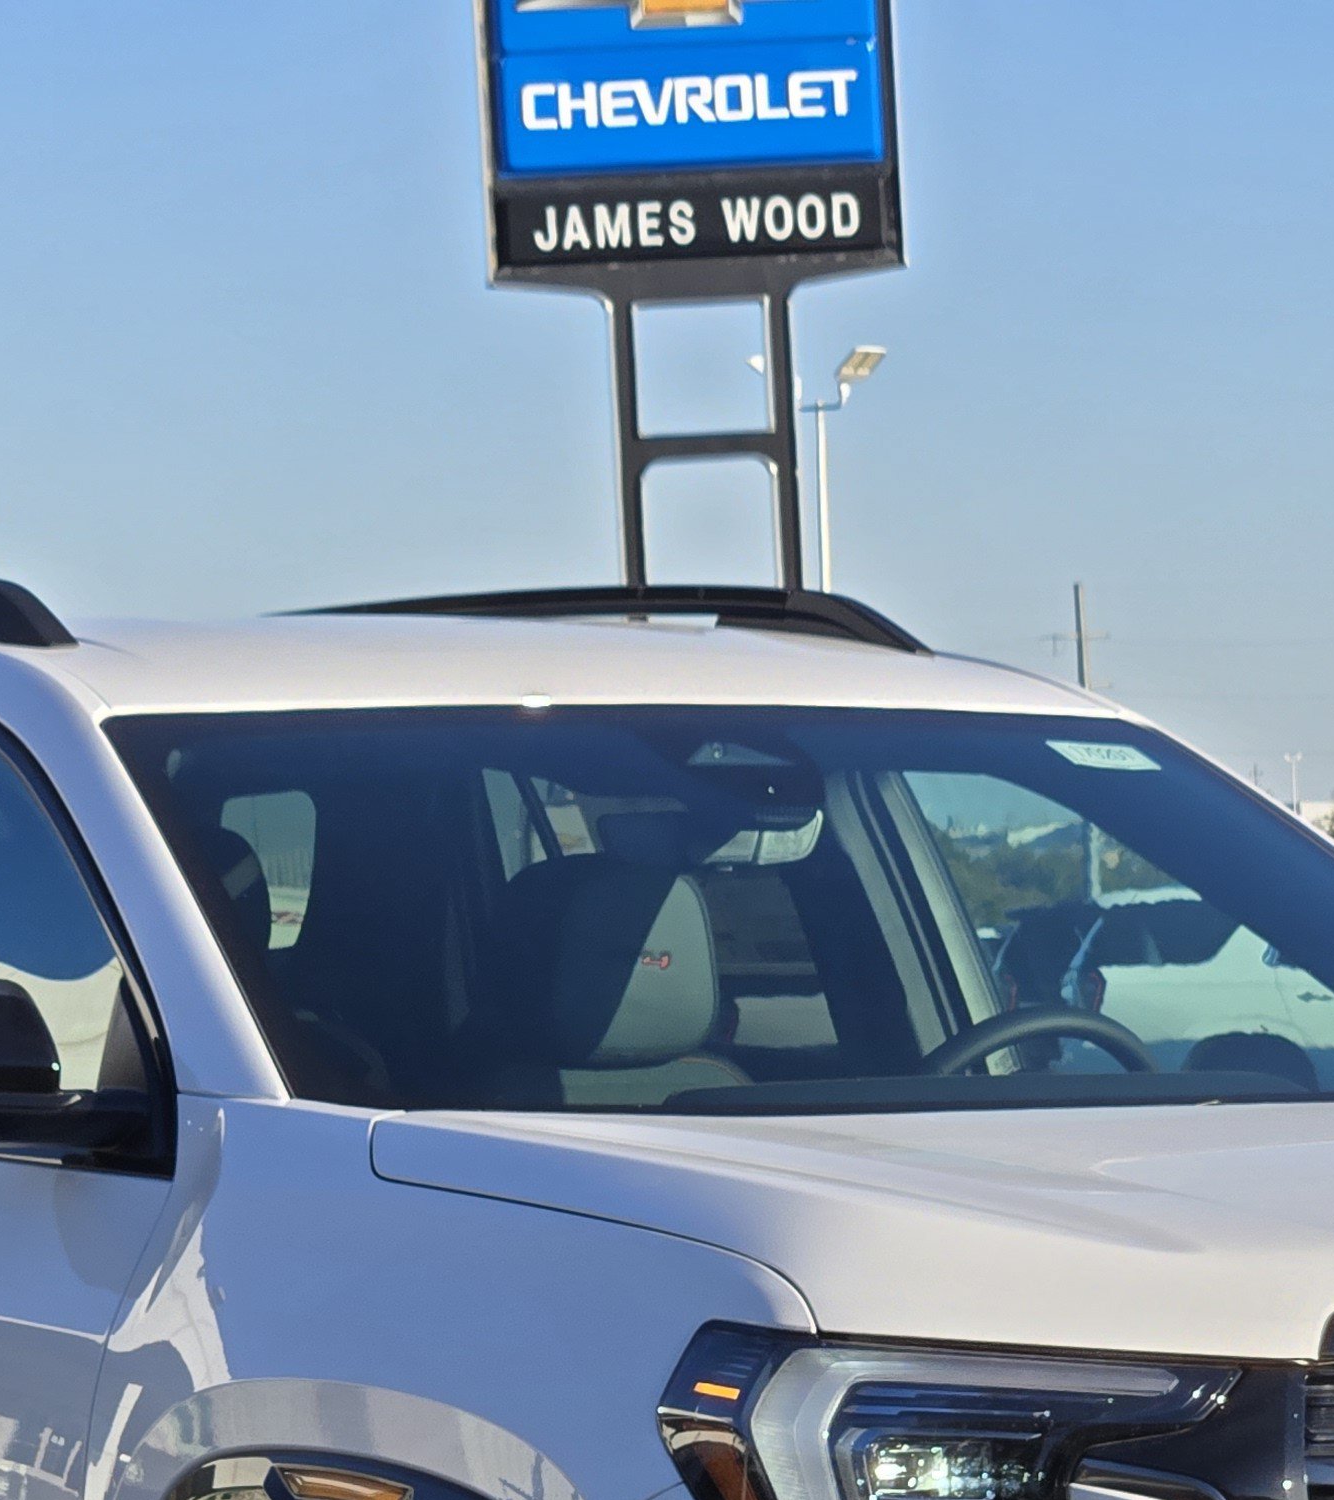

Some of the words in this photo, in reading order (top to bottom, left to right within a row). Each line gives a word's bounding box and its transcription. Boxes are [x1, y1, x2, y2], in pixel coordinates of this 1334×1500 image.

[521, 69, 858, 130] CHEVROLET
[533, 200, 695, 252] JAMES
[721, 192, 860, 243] WOOD
